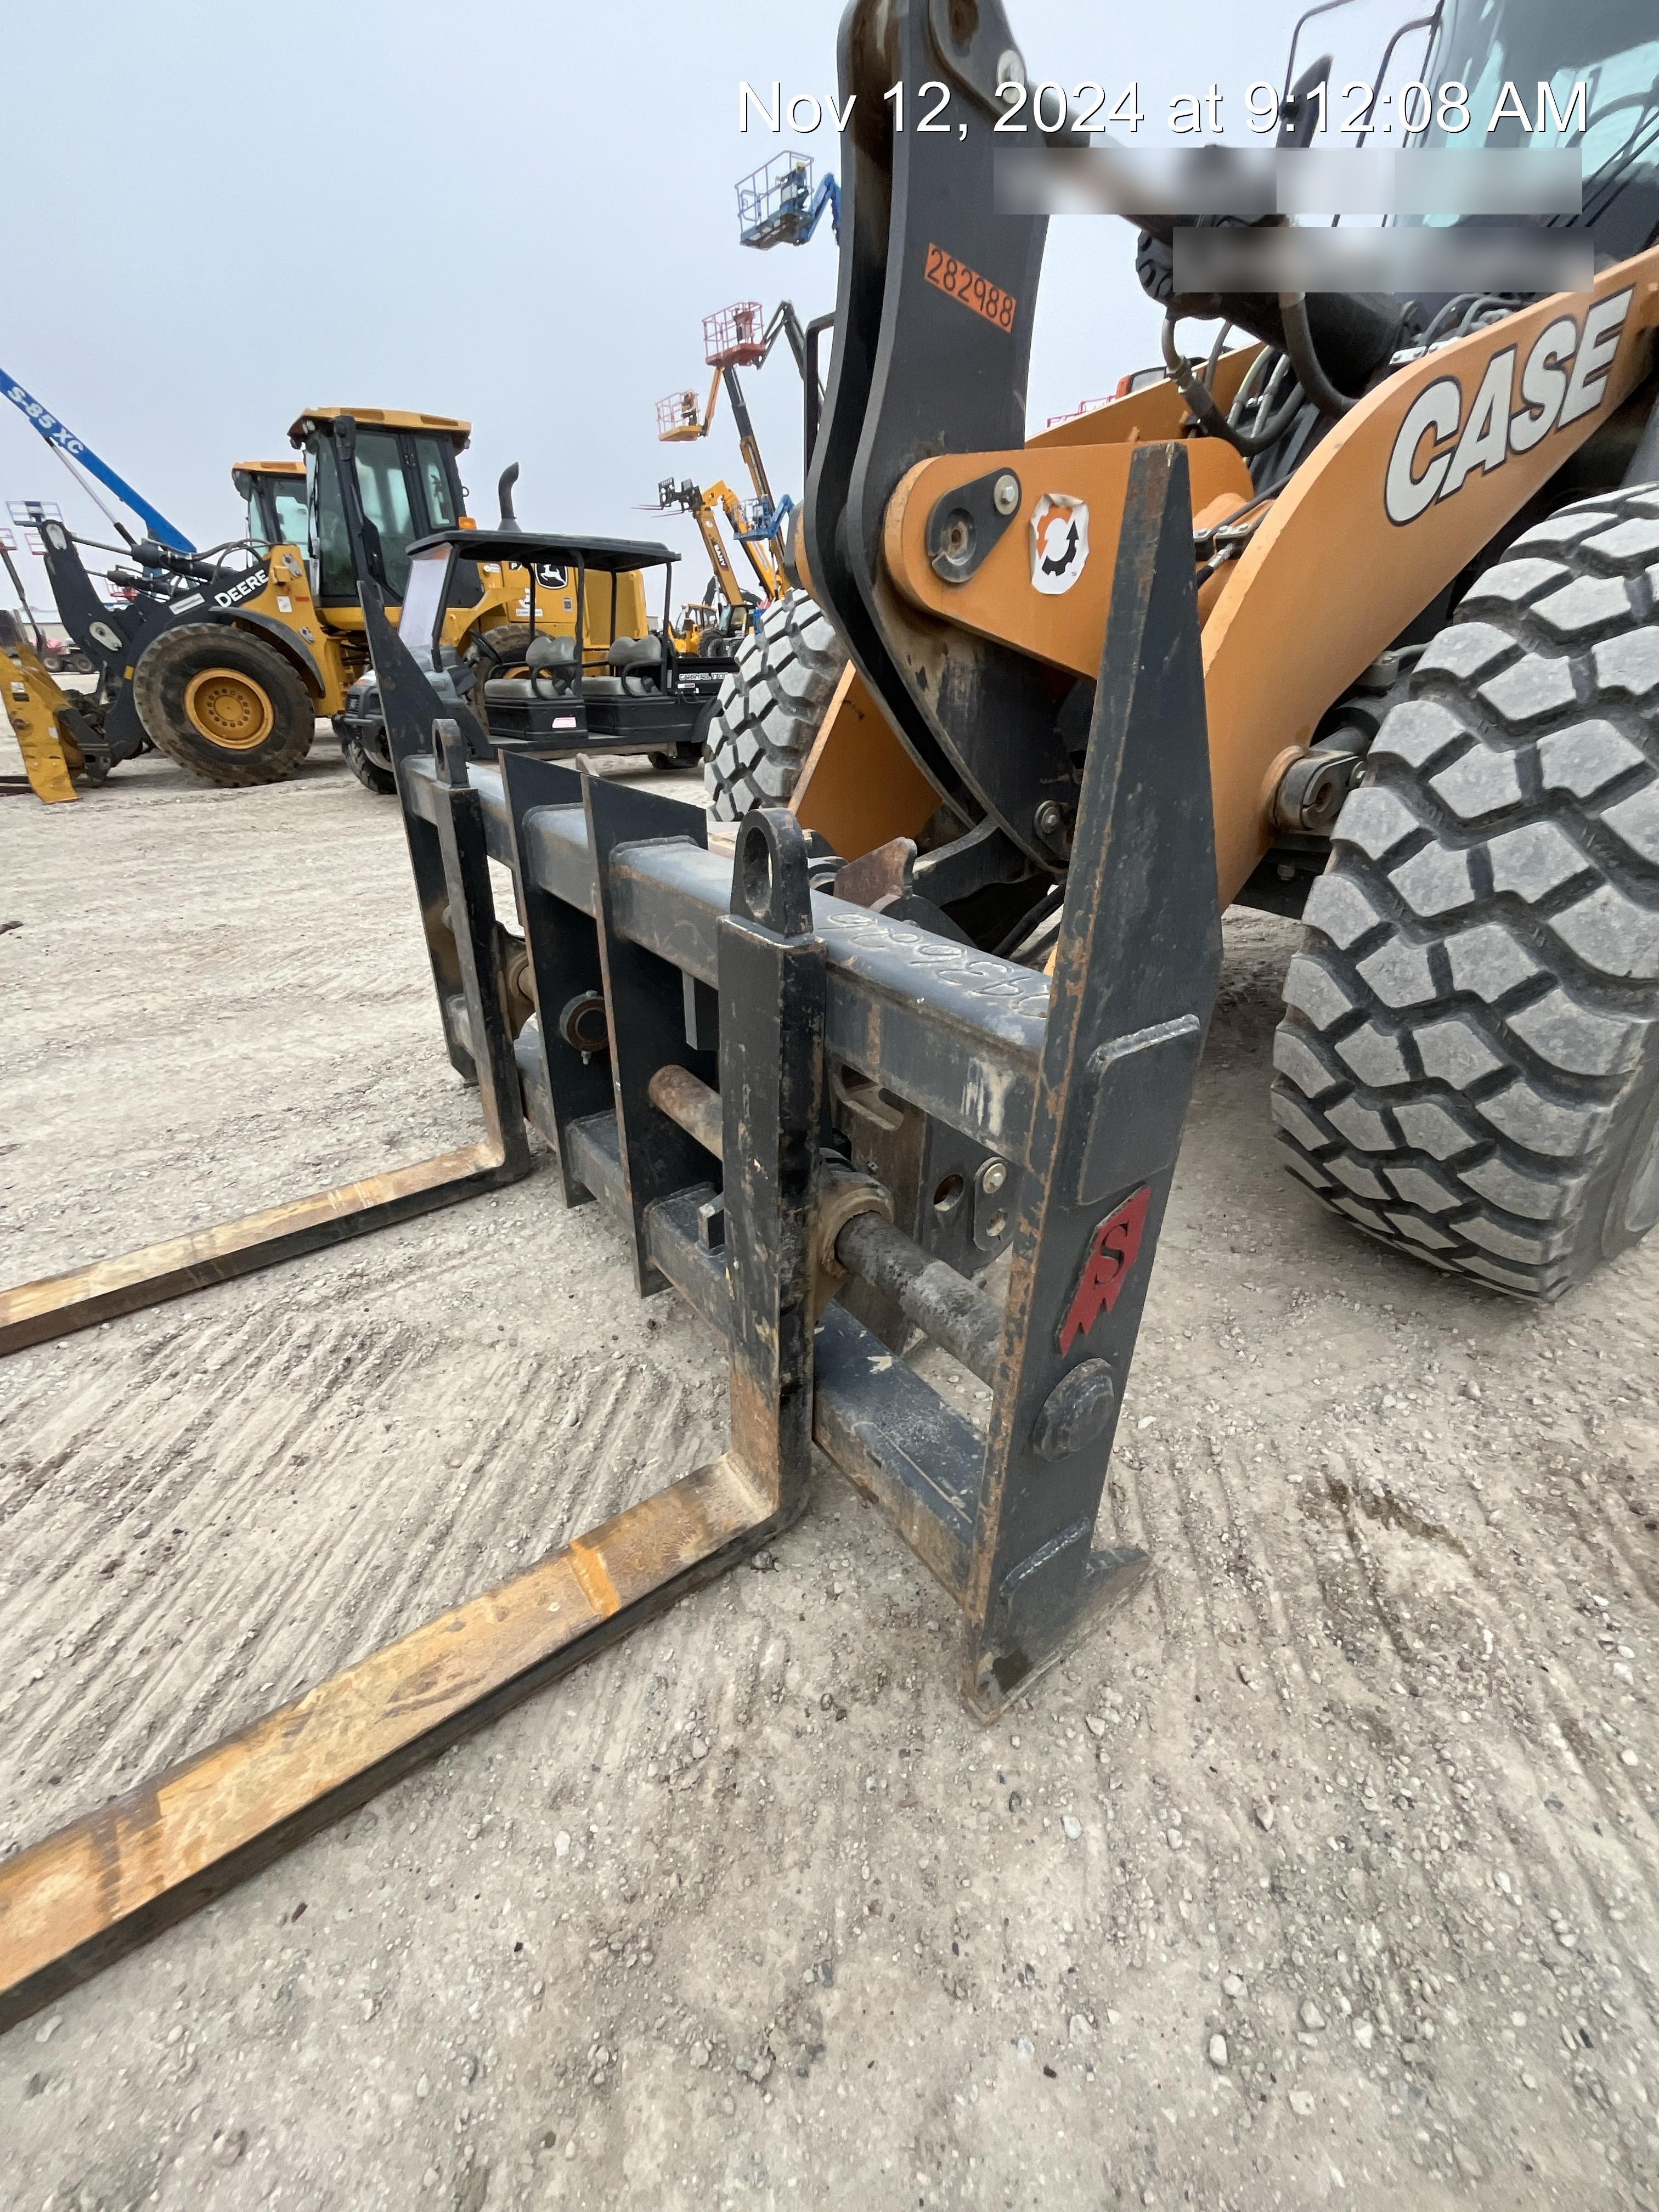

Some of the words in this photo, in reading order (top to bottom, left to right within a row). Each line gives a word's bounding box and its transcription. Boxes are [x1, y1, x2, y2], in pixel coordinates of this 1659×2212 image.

[927, 249, 1013, 327] 282988
[8, 386, 57, 428] S-85
[52, 427, 84, 454] XC
[1385, 282, 1637, 527] CASE
[214, 569, 269, 608] DEERE
[713, 544, 726, 566] SANY
